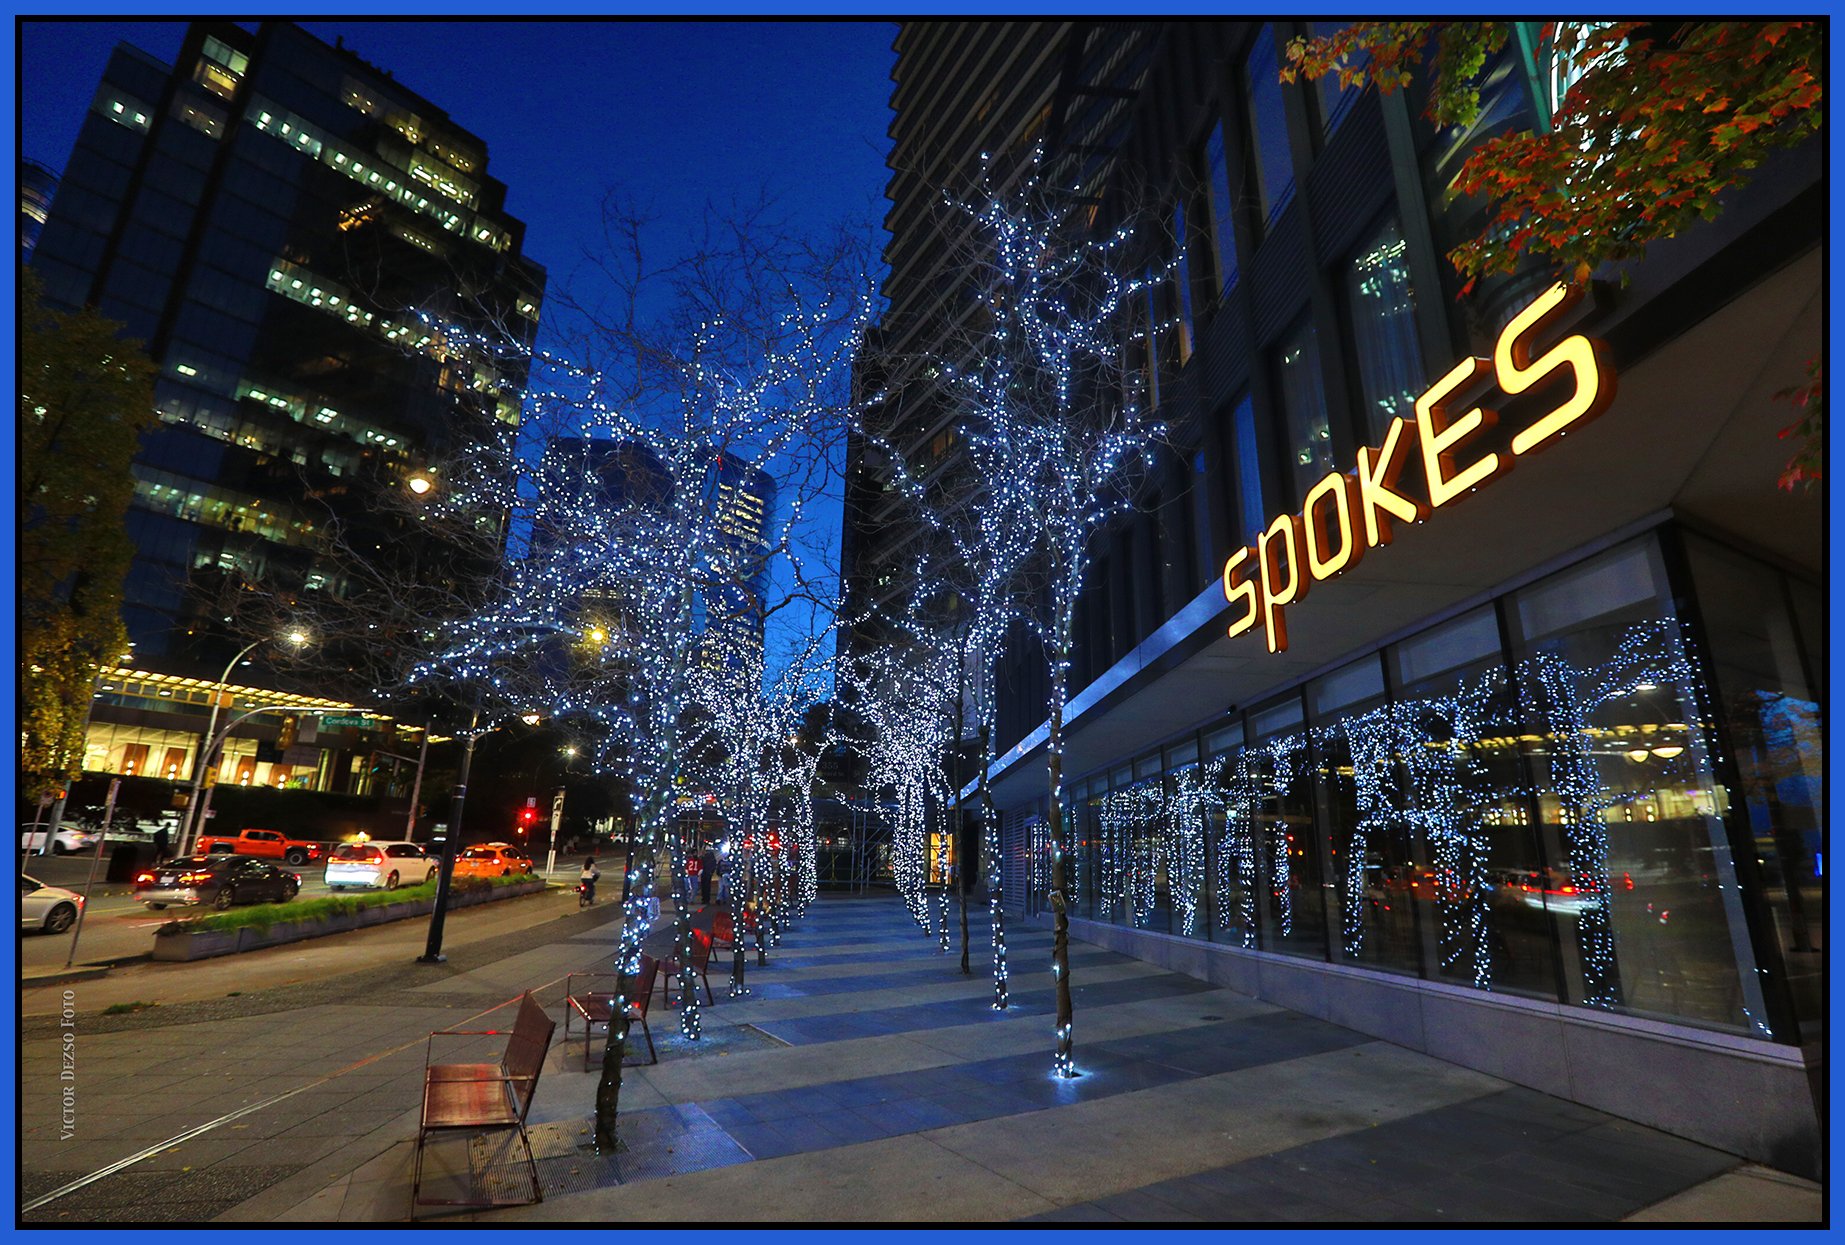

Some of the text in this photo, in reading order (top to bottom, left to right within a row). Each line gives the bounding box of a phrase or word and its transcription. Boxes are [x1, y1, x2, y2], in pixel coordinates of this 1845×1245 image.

[325, 717, 371, 727] Cordova St
[688, 860, 699, 872] 21
